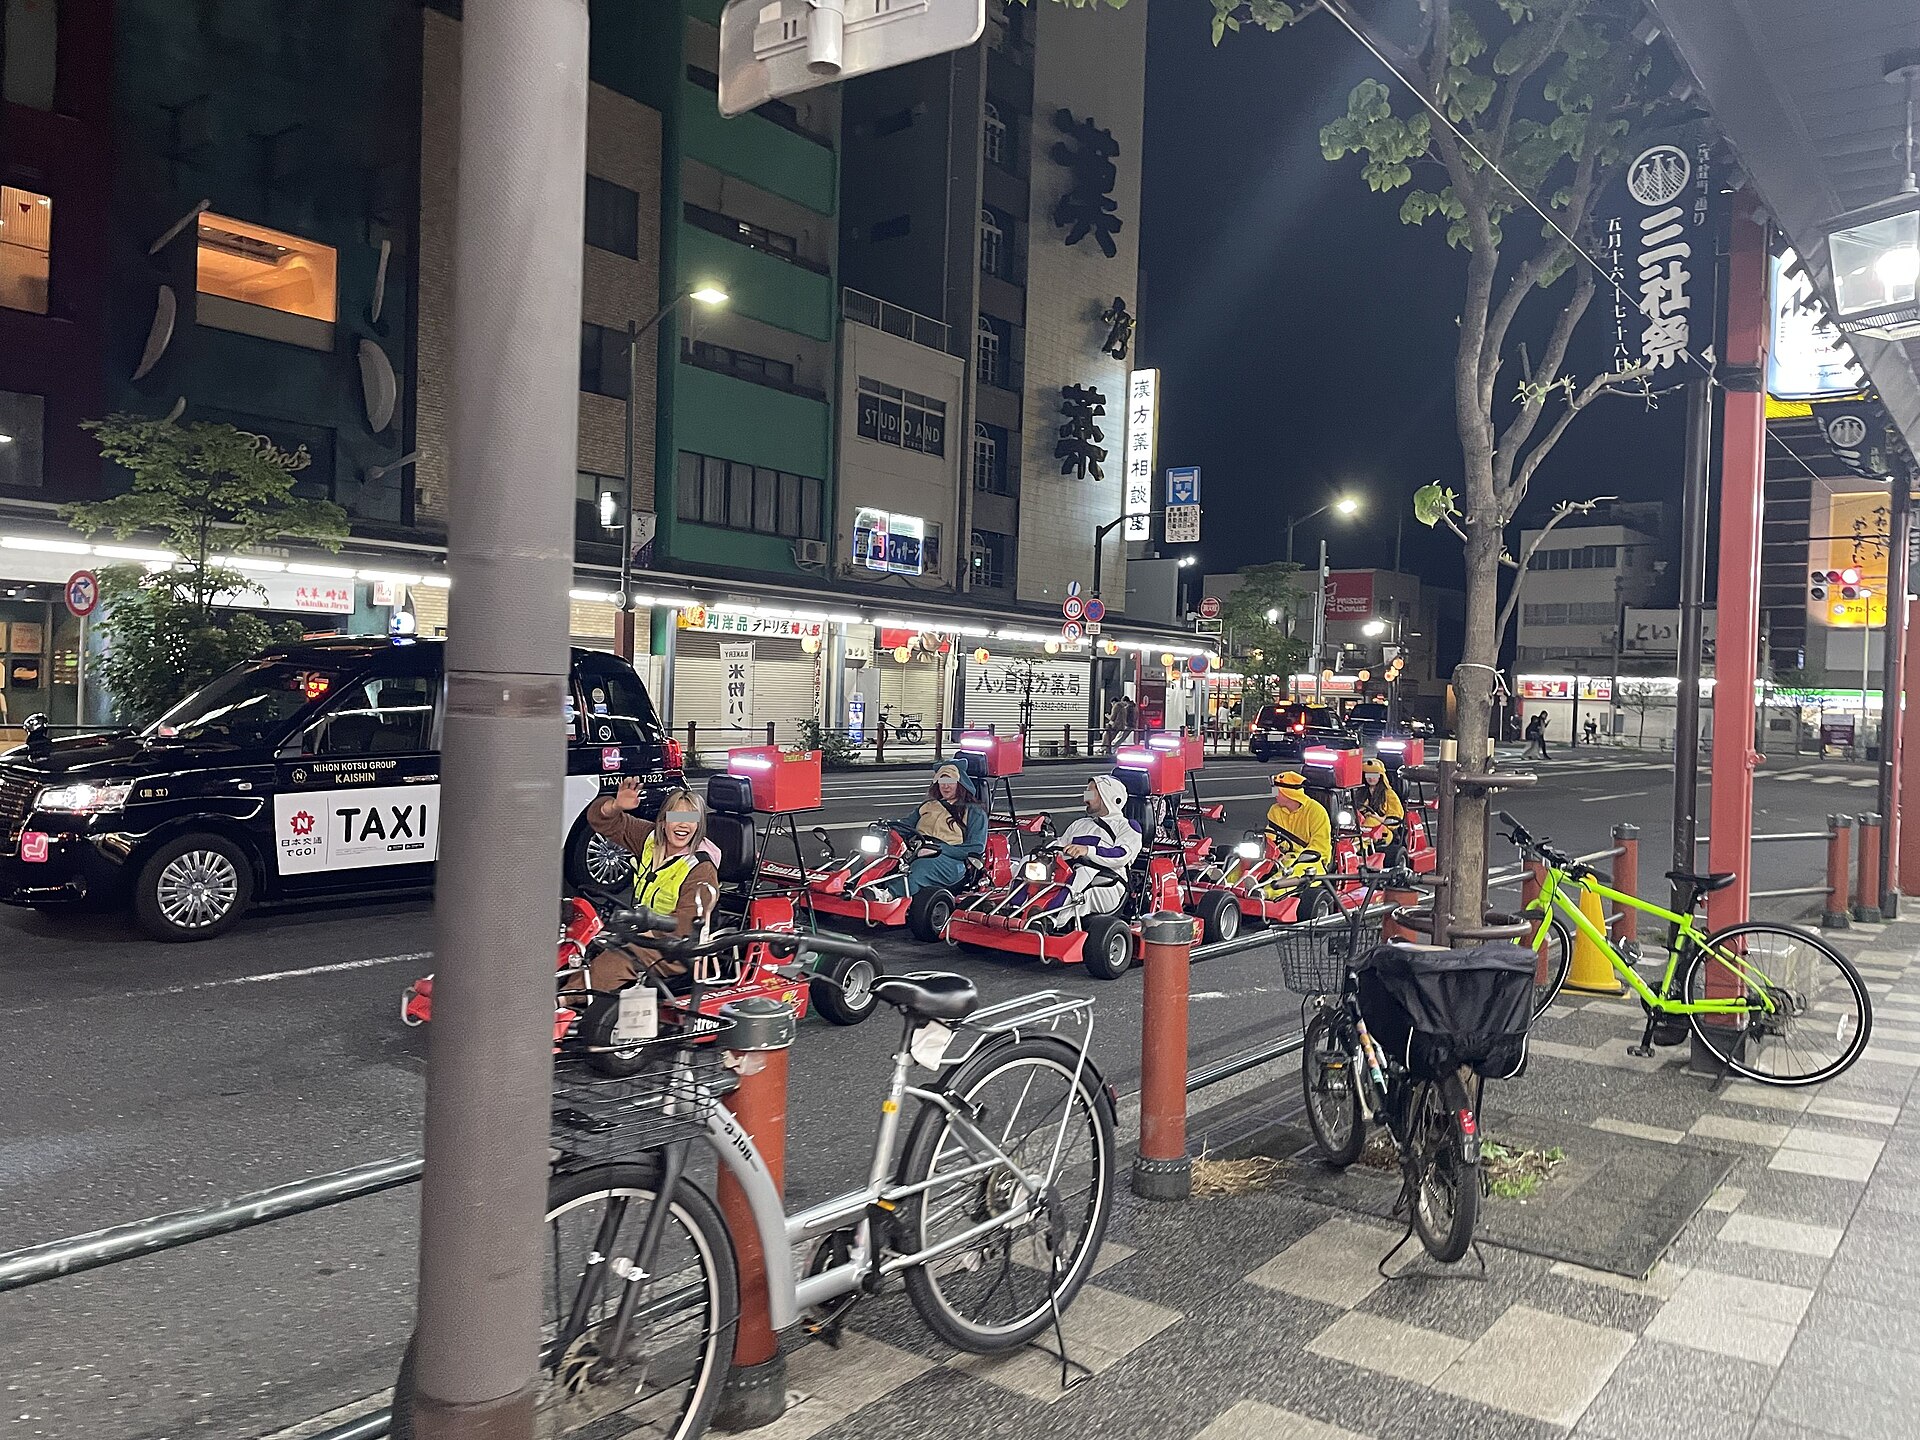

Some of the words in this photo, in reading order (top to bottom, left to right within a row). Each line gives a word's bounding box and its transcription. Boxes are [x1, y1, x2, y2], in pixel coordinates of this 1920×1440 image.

[1637, 206, 1691, 370] 三社祭
[865, 408, 911, 436] STUDIO
[915, 423, 940, 443] AND
[1068, 603, 1080, 613] 40
[1336, 604, 1368, 612] Donut
[313, 762, 340, 772] NIHON
[341, 761, 368, 771] KOTSU
[369, 760, 397, 770] GROUP
[335, 772, 376, 783] KAISHIN
[642, 774, 664, 783] 7322
[335, 804, 427, 843] TAXI
[281, 837, 323, 847] 日本交通
[286, 847, 317, 857] でGO!
